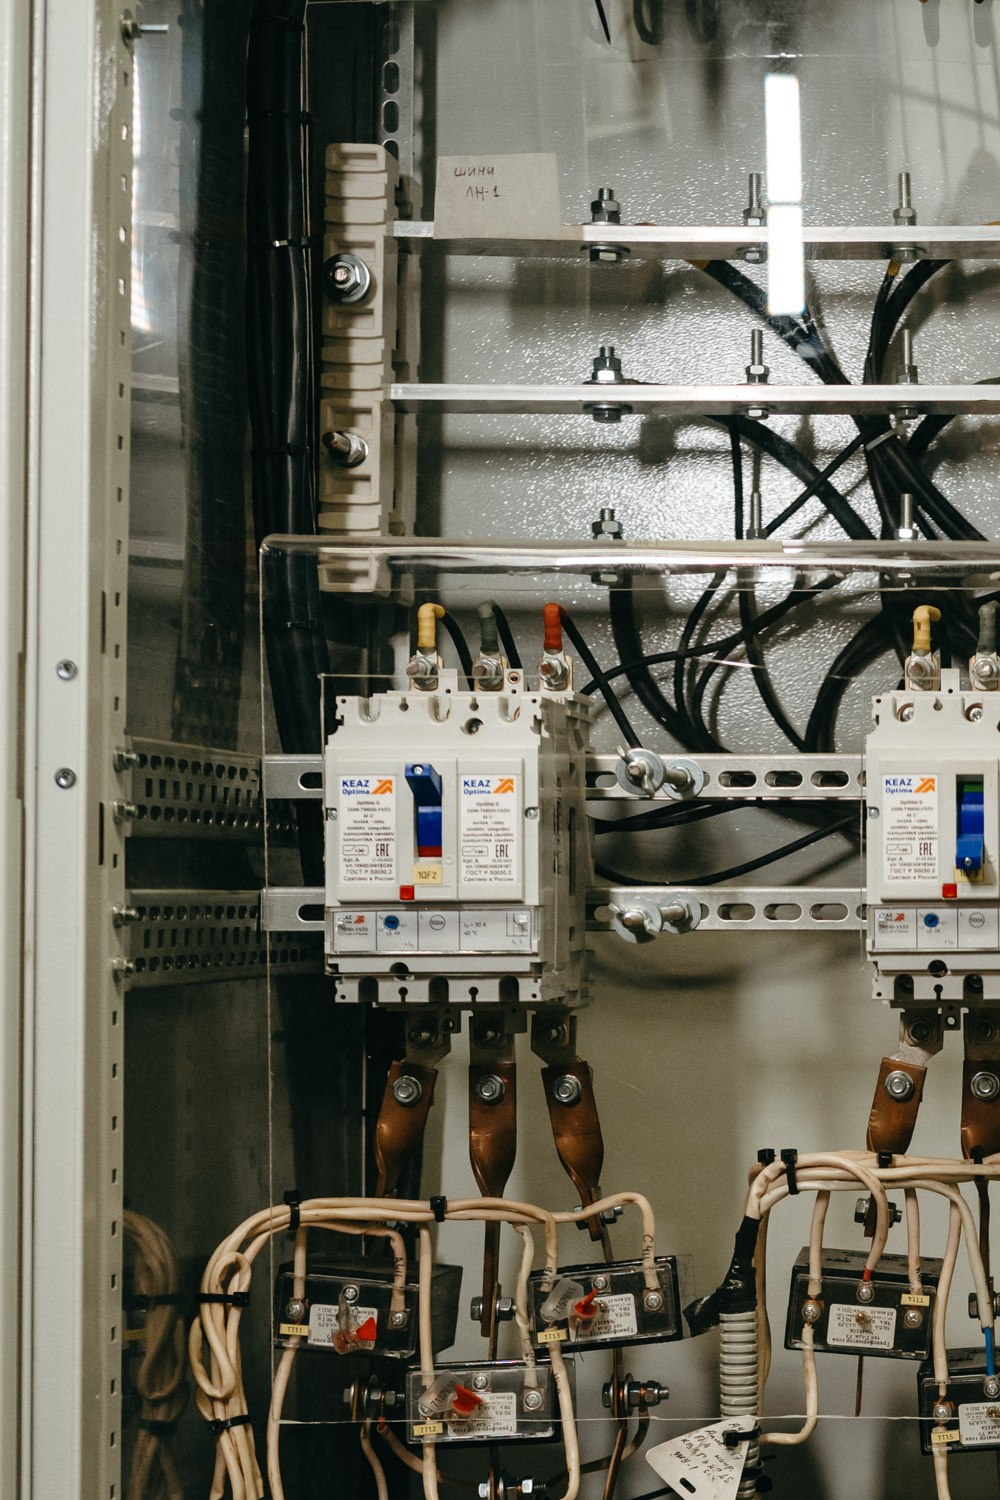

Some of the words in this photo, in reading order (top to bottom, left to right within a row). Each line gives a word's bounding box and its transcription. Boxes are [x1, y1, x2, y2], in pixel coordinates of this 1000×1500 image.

[376, 843, 390, 857] EAC
[495, 844, 509, 857] EAC
[919, 842, 933, 855] EAC
[418, 871, 437, 879] 1QF2
